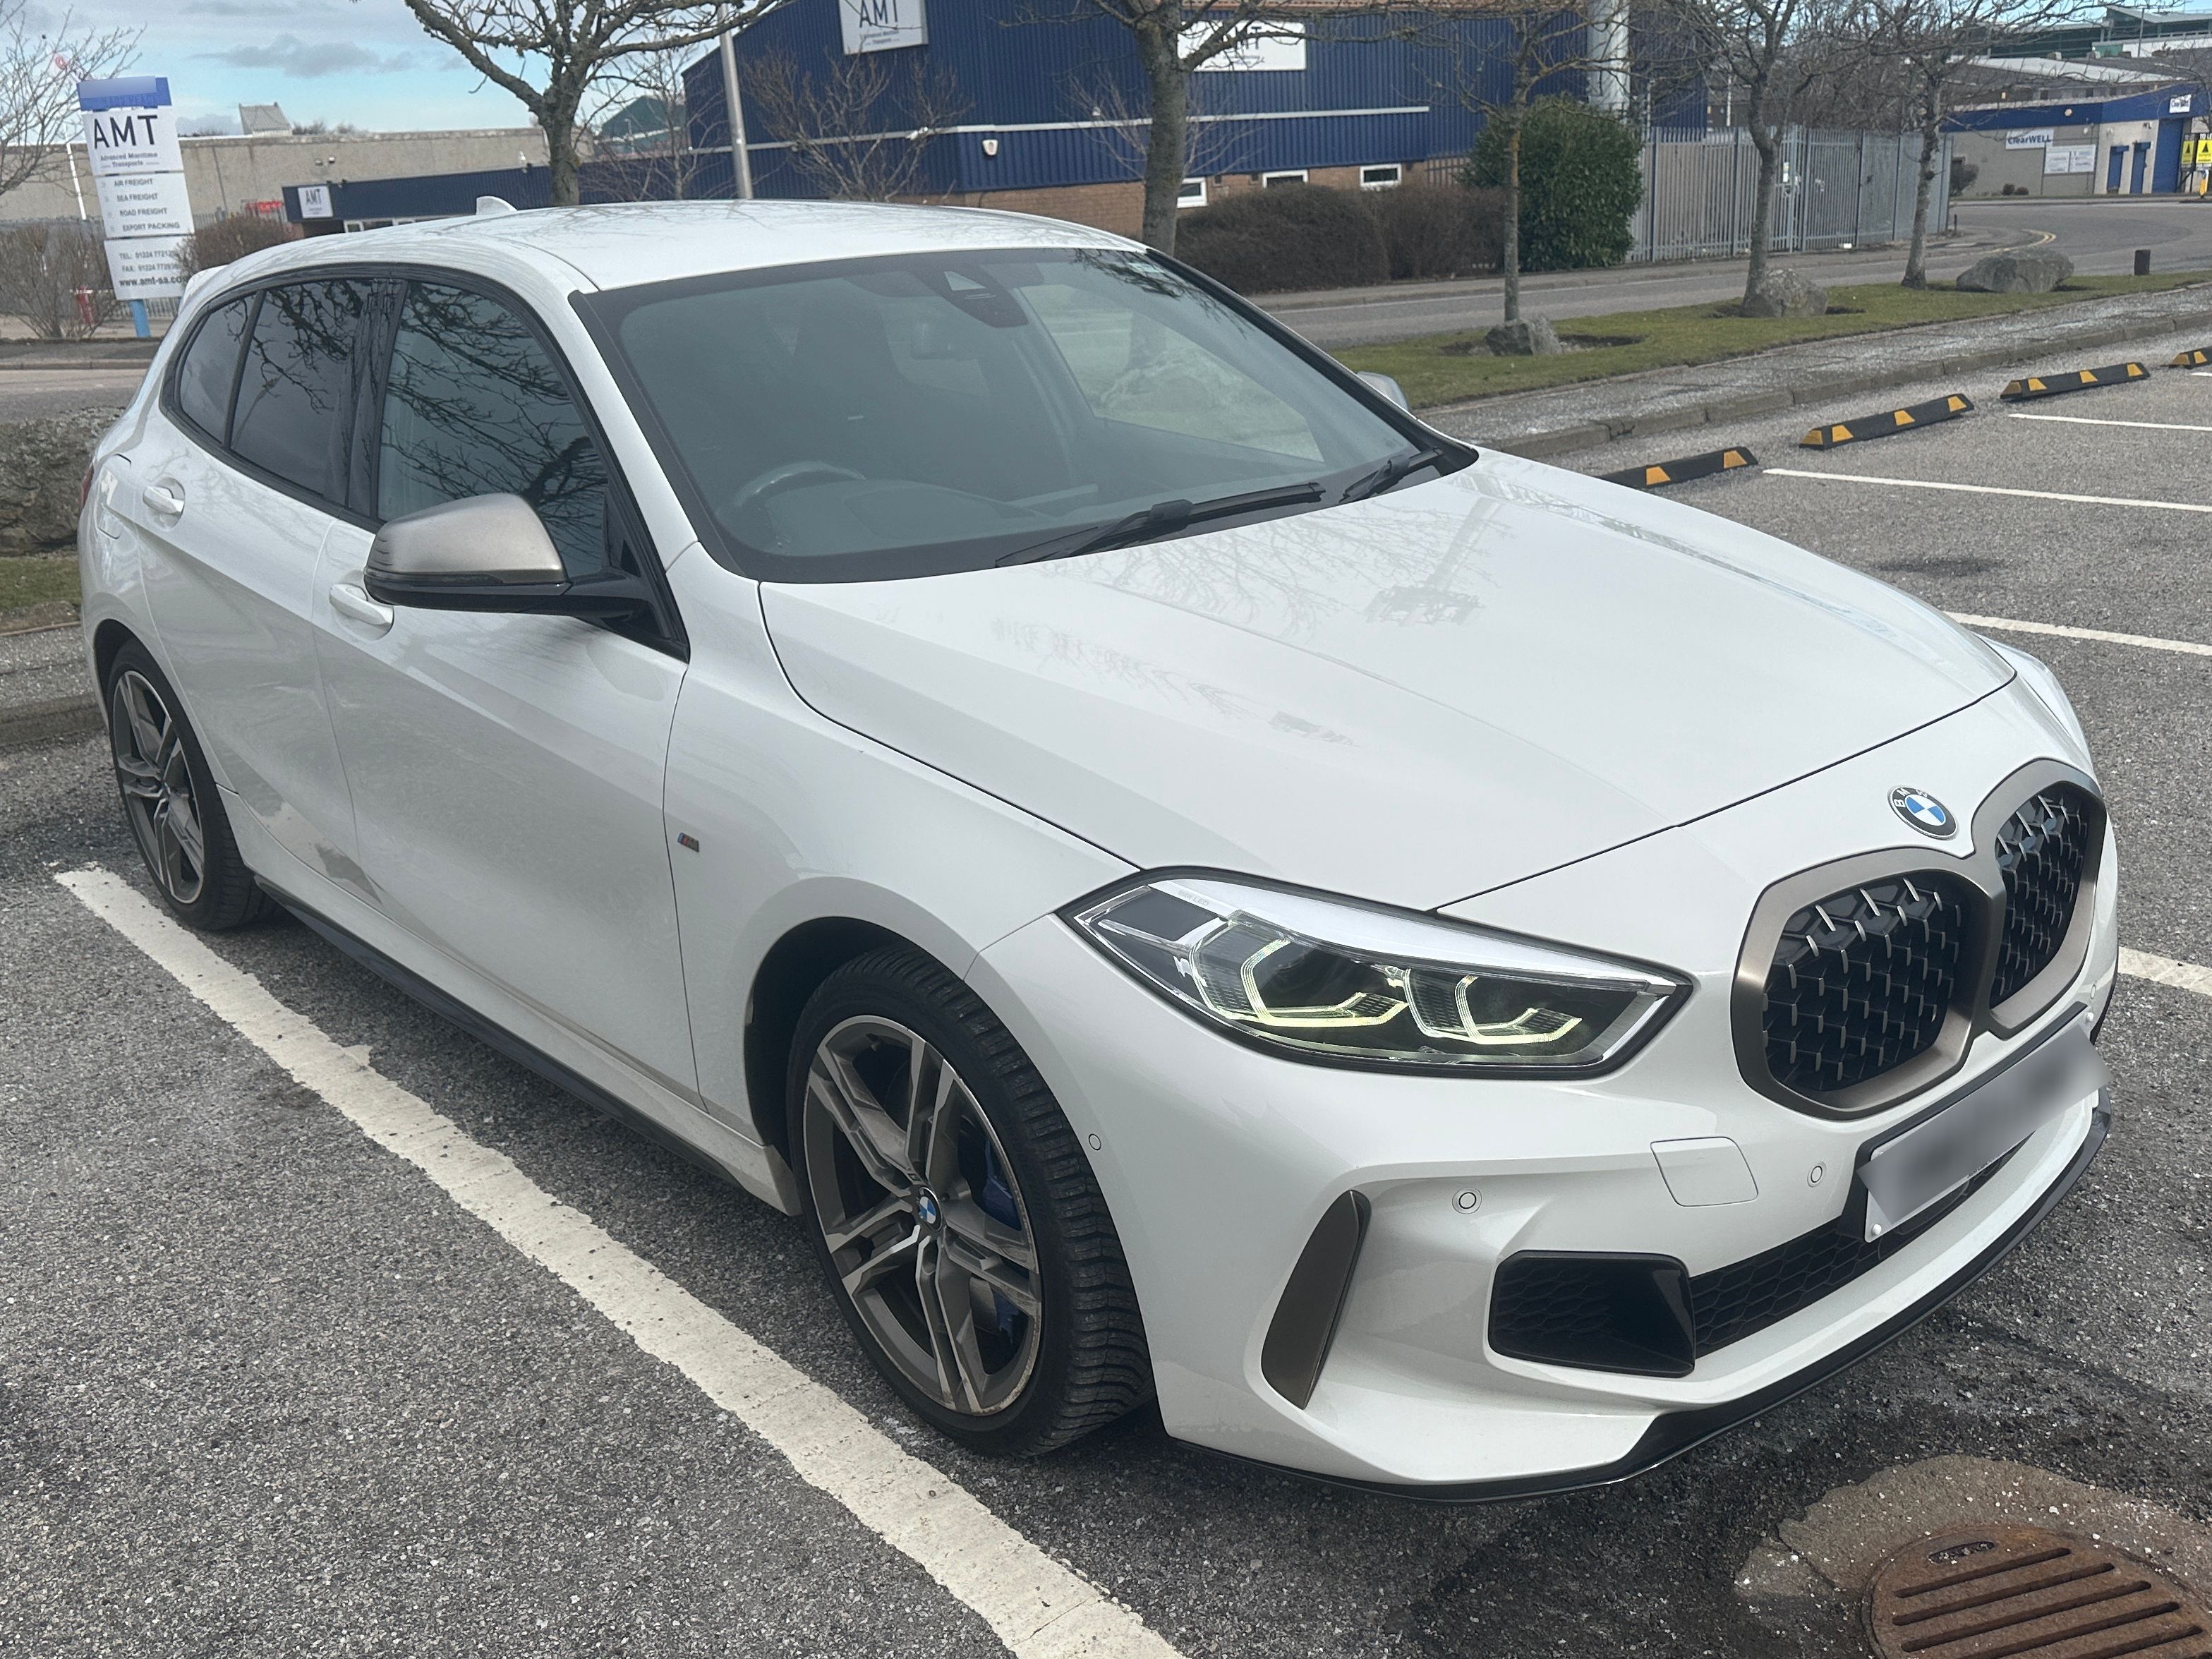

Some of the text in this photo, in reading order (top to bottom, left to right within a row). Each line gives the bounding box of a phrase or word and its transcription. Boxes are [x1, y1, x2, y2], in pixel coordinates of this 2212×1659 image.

[95, 115, 157, 149] AMT
[122, 223, 146, 231] EXPORT
[119, 276, 185, 286] www.amt-sa.co
[1893, 788, 1928, 808] BMW
